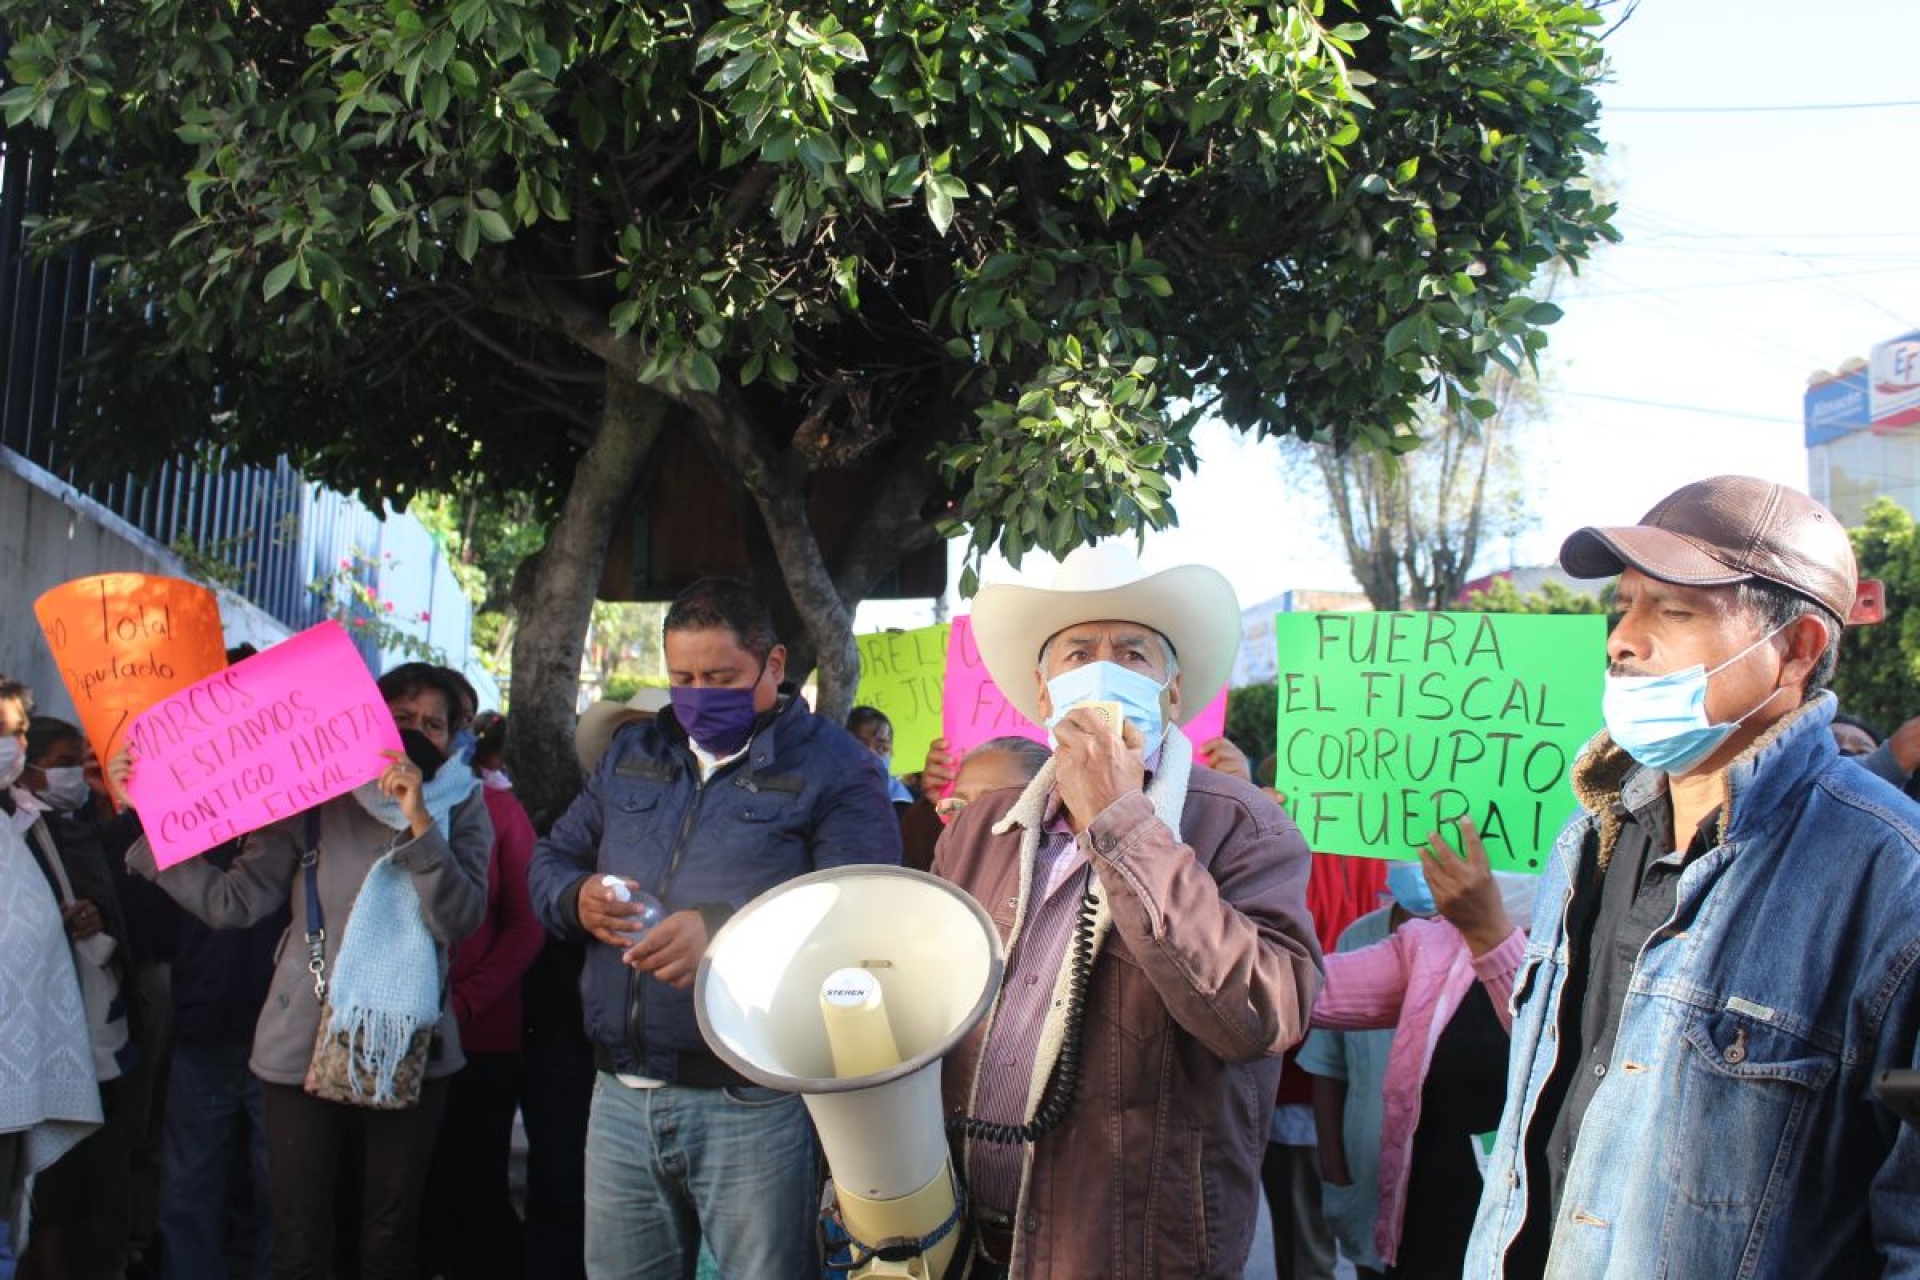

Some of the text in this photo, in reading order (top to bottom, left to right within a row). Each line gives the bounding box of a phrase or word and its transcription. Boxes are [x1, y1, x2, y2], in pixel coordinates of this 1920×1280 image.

[1314, 612, 1504, 671] FUERA
[133, 671, 254, 760] MARCOS
[1284, 671, 1566, 728] EL FISCAL
[160, 703, 382, 843] CONTIGO HASTA
[169, 690, 317, 791] ESTAMOS
[1286, 727, 1566, 795] CORRUPTO
